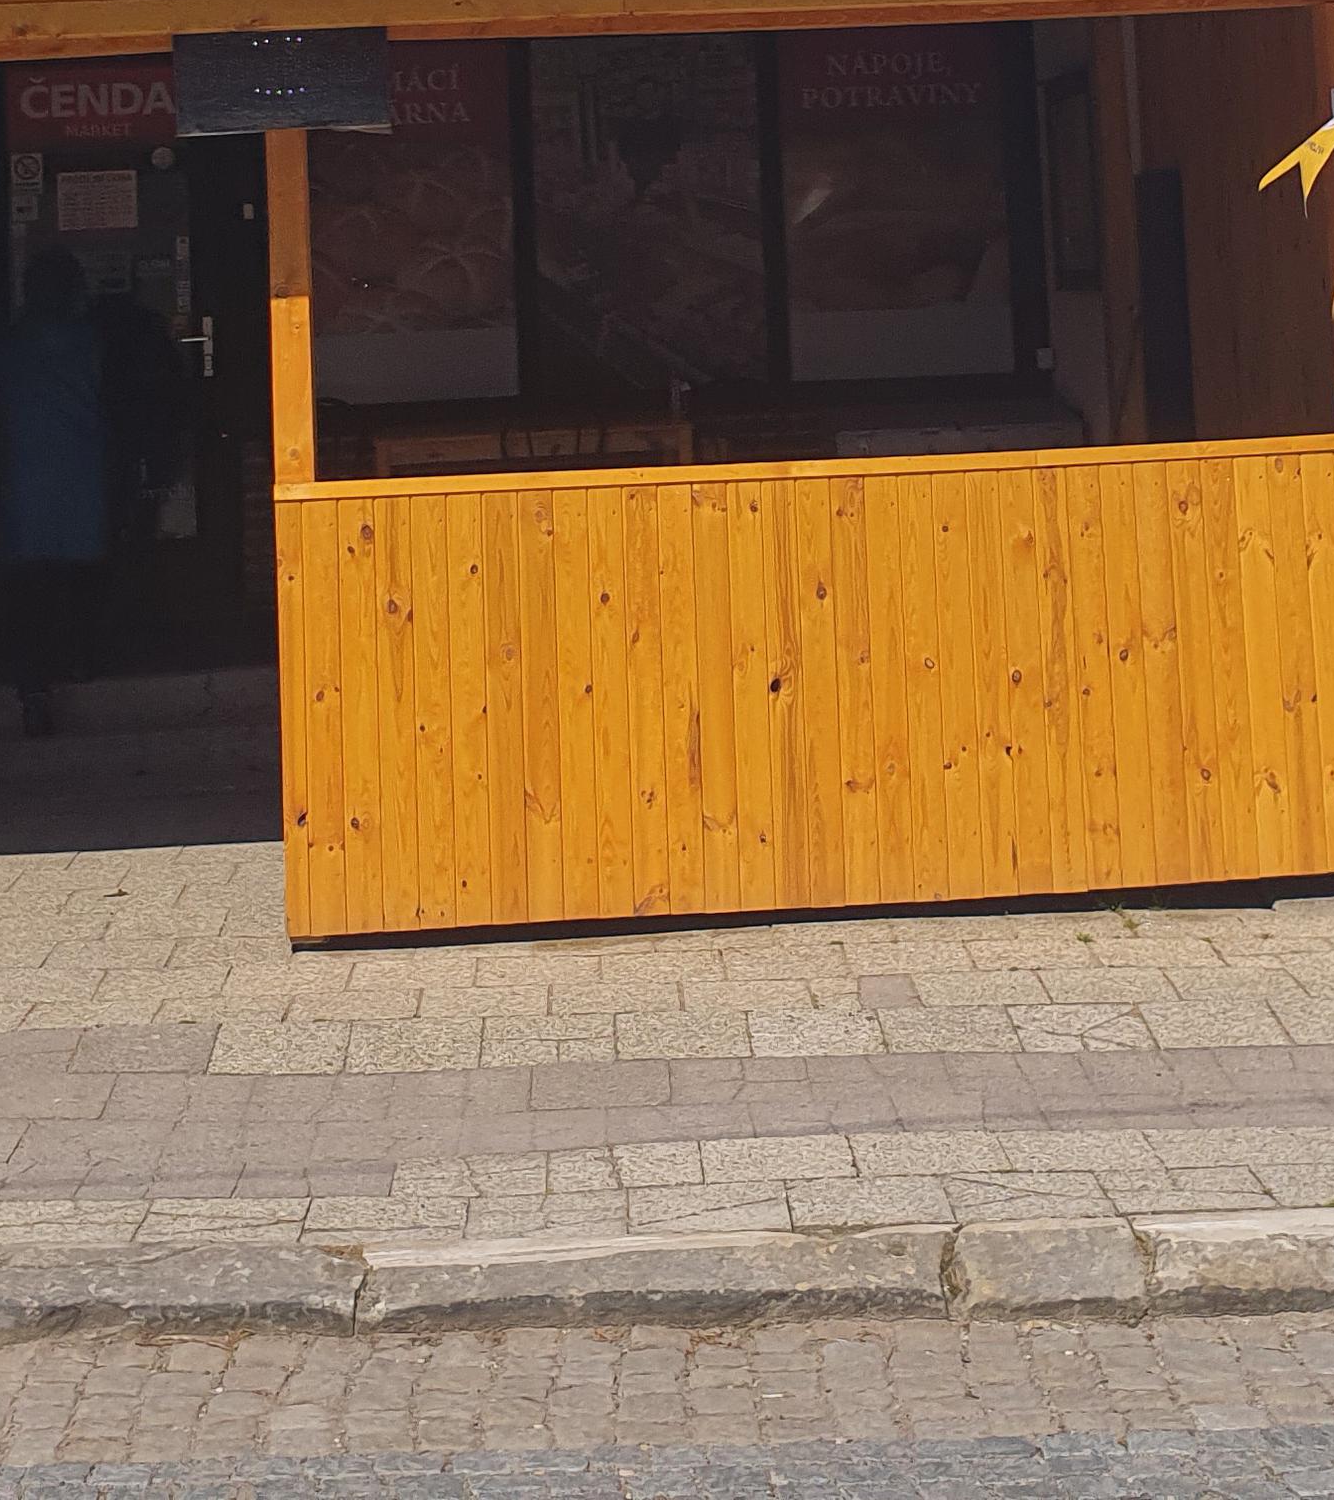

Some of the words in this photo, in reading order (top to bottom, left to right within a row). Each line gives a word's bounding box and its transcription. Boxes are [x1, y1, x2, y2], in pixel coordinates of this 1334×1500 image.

[19, 76, 176, 119] ČENDA
[801, 82, 981, 110] POTRAVINY
[65, 122, 132, 139] MARKET
